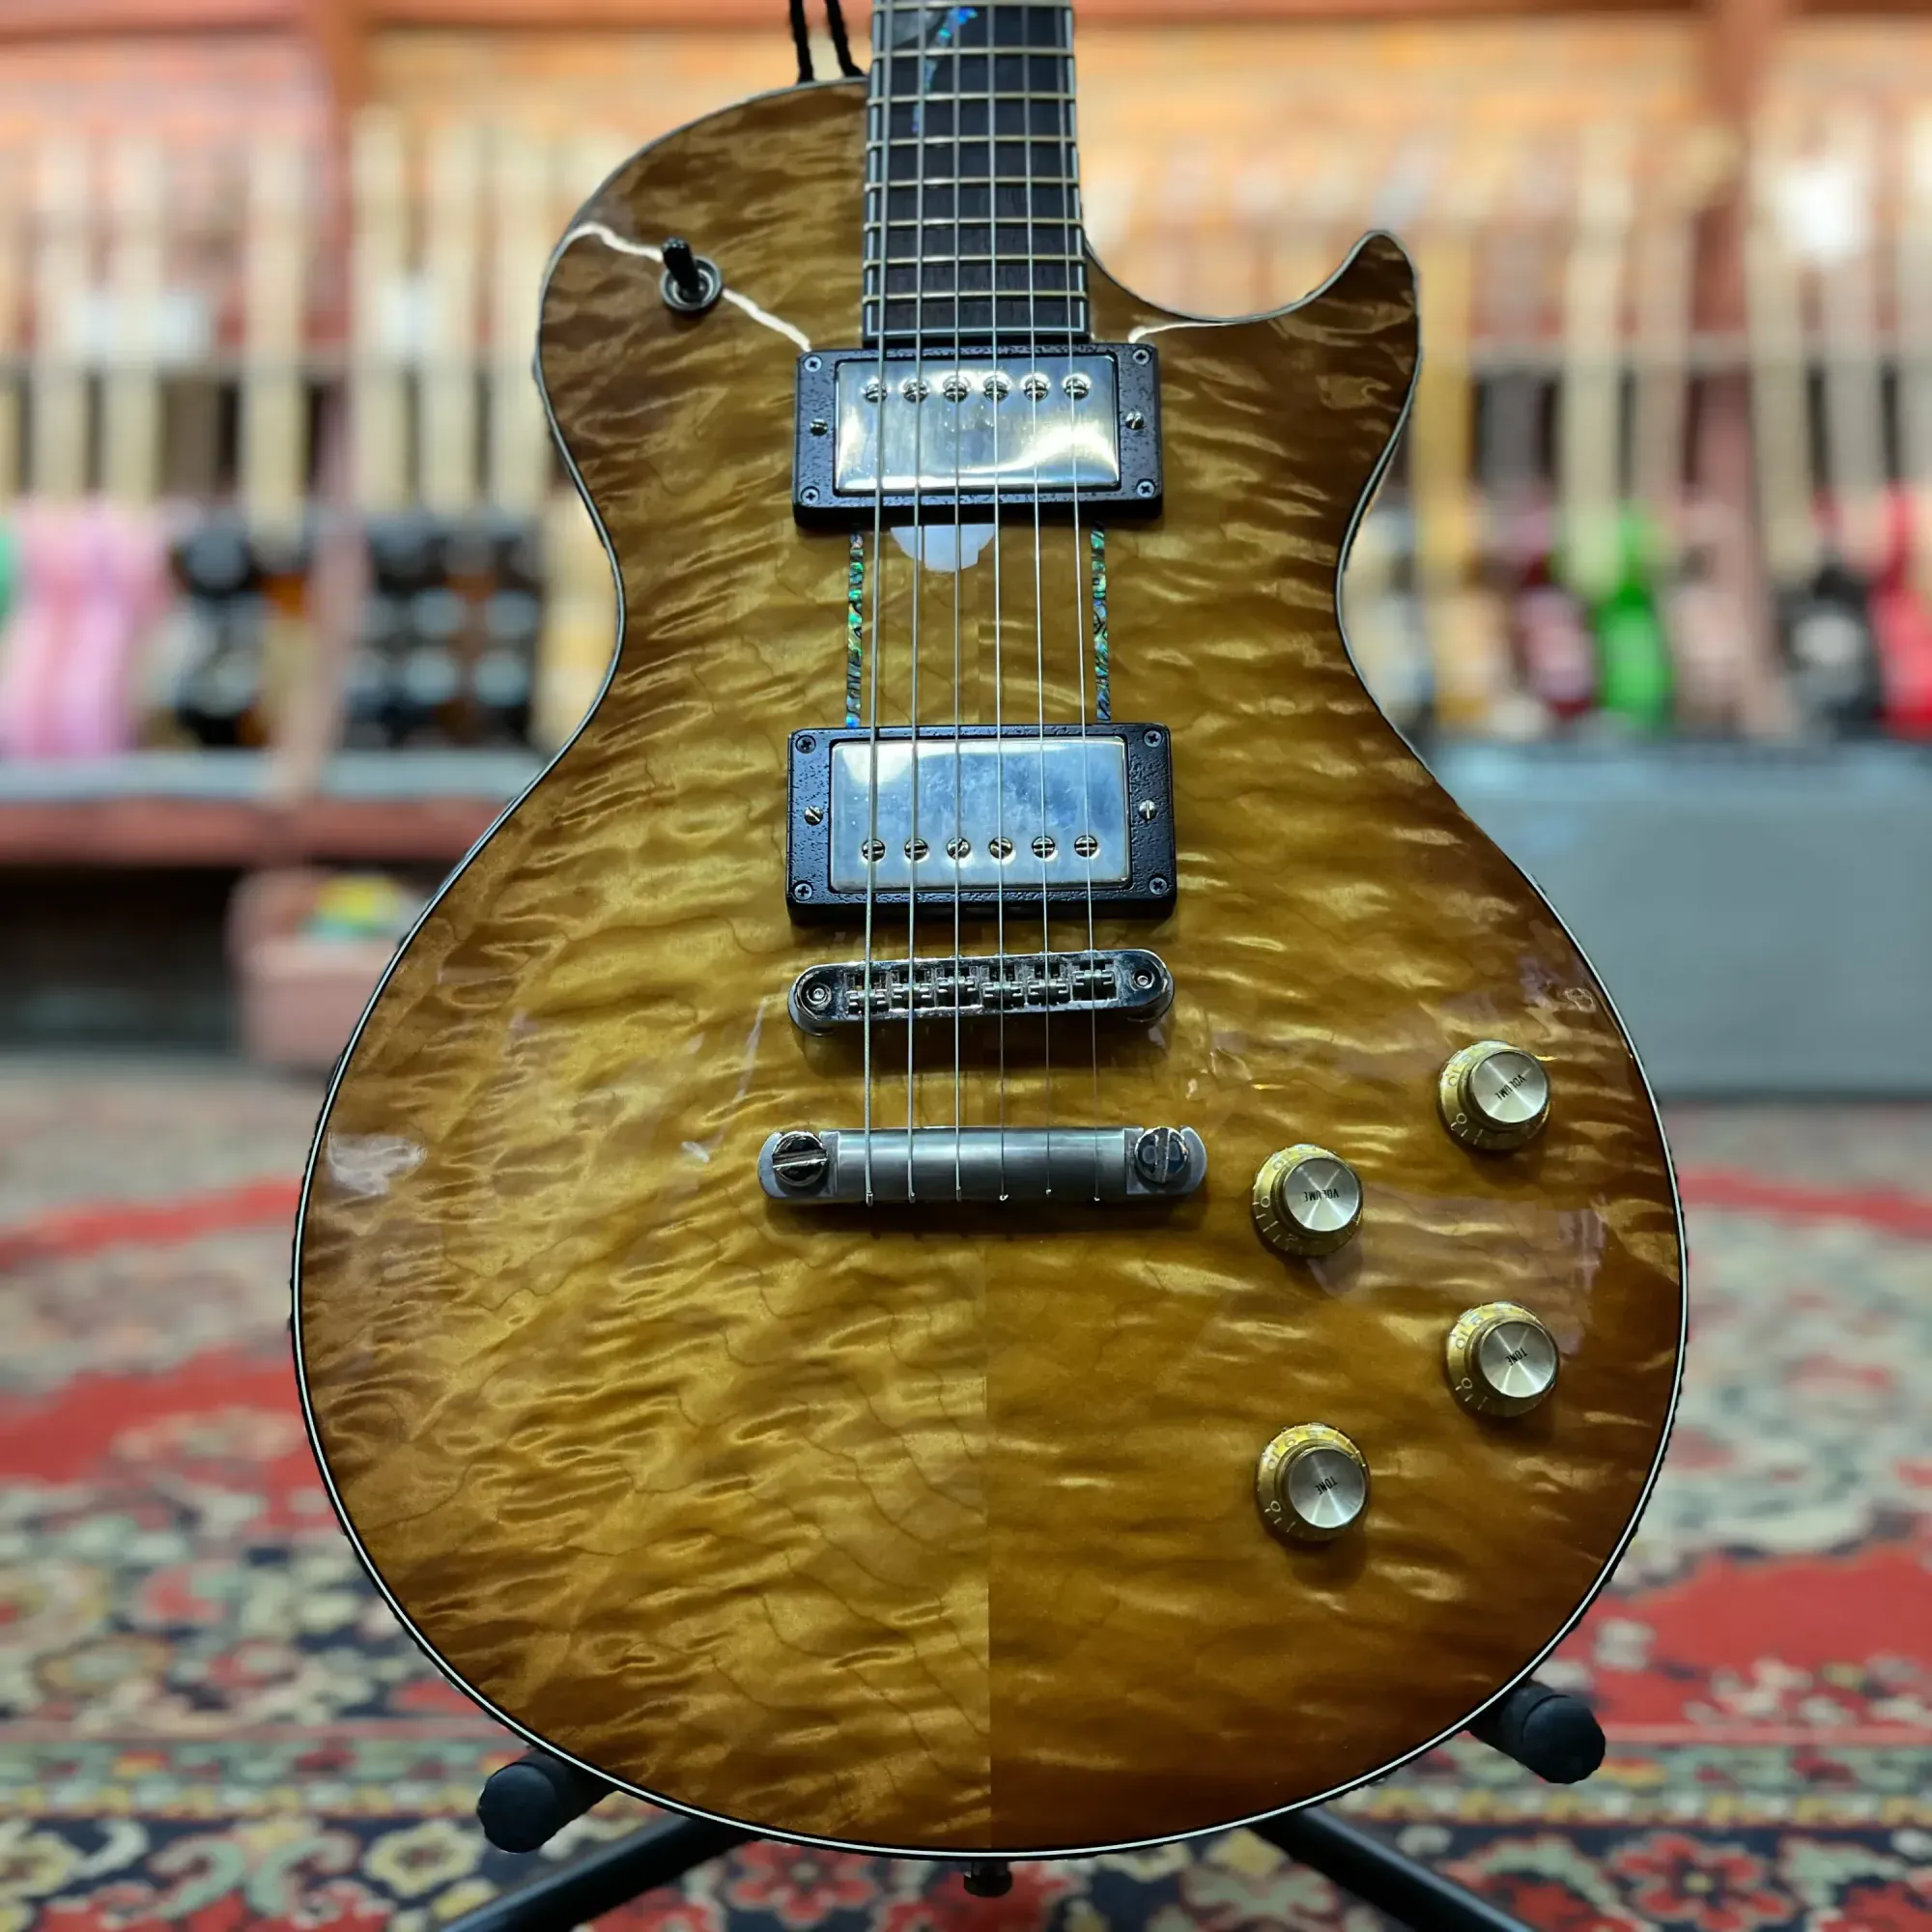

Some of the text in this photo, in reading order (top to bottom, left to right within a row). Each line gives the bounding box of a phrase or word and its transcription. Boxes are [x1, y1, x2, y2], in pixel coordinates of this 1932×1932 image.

[1495, 1074, 1526, 1101] VOLUME
[1304, 1188, 1339, 1202] VOLUME
[1505, 1347, 1528, 1366] TONE
[1315, 1476, 1338, 1495] TONE
